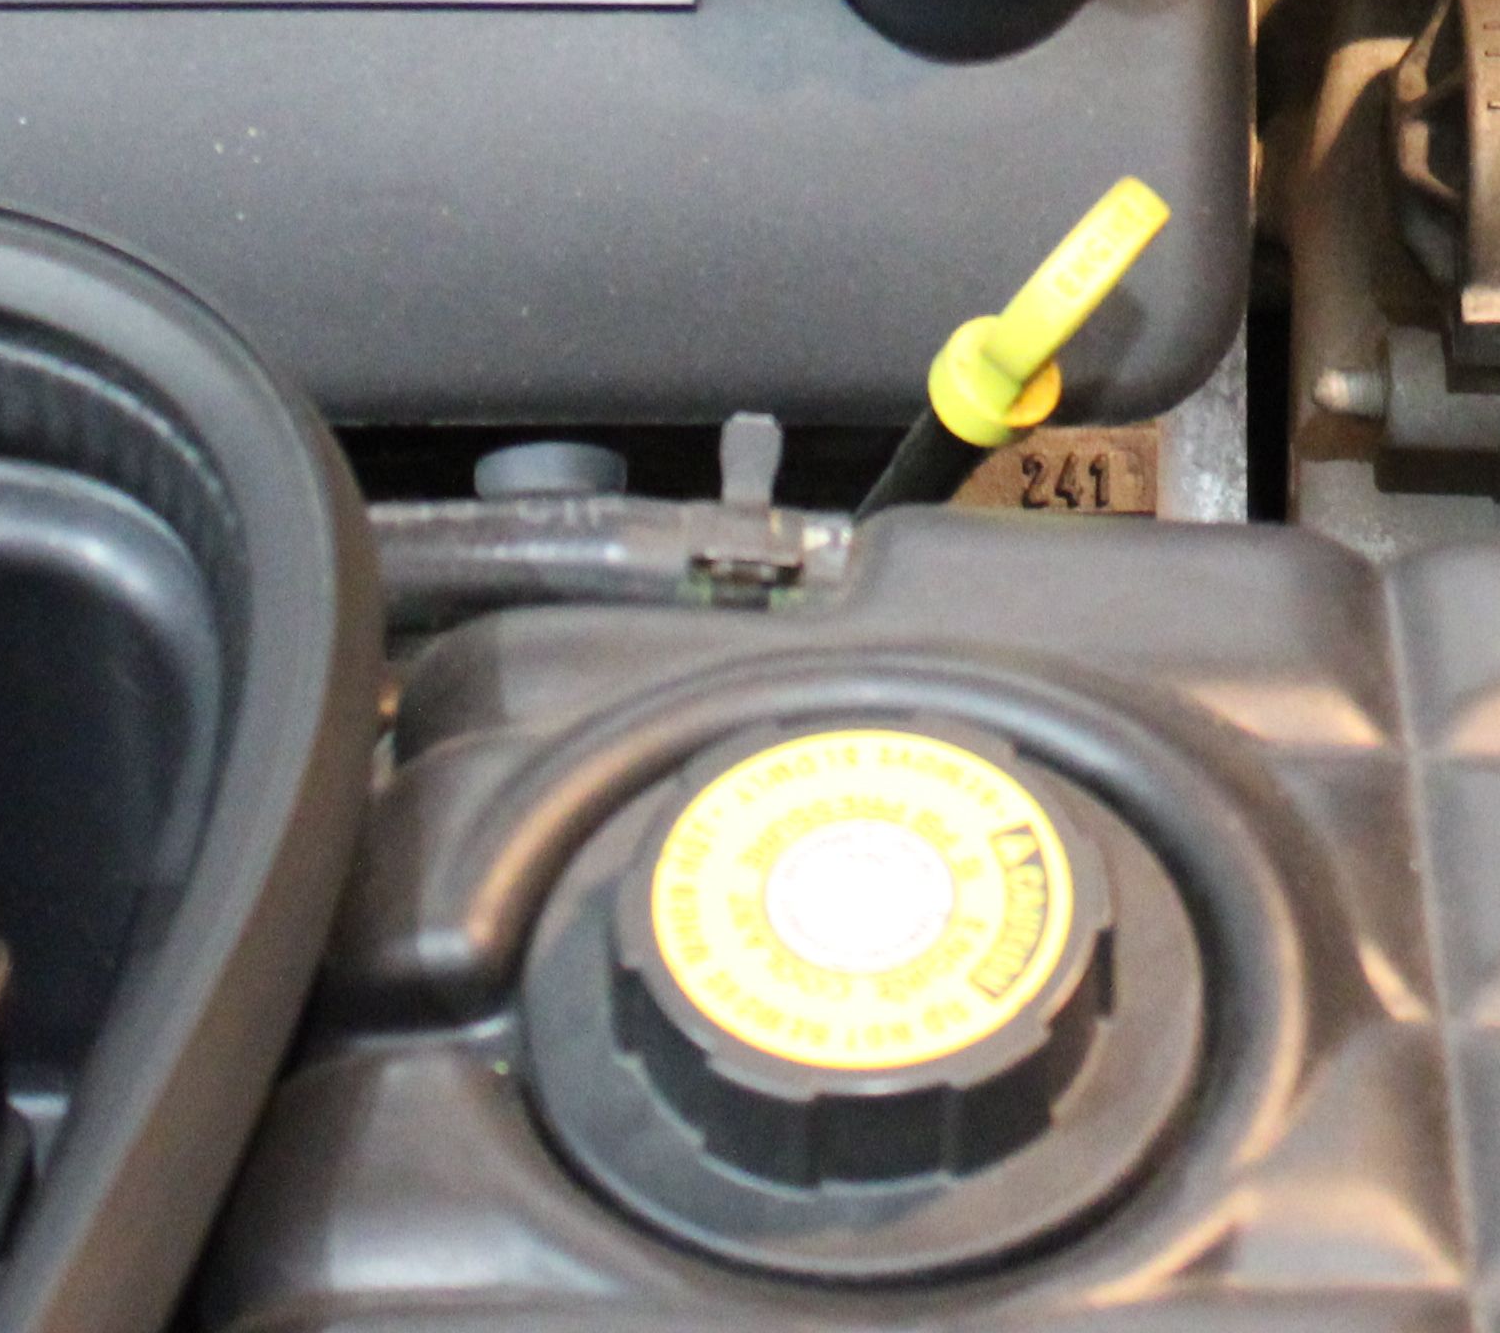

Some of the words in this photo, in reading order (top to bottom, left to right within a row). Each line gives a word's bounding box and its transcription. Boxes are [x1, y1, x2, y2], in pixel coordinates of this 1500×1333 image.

[1021, 452, 1112, 509] 241
[704, 970, 832, 1047] REMOVE
[923, 1000, 971, 1033] DO
[845, 1023, 913, 1052] NOT
